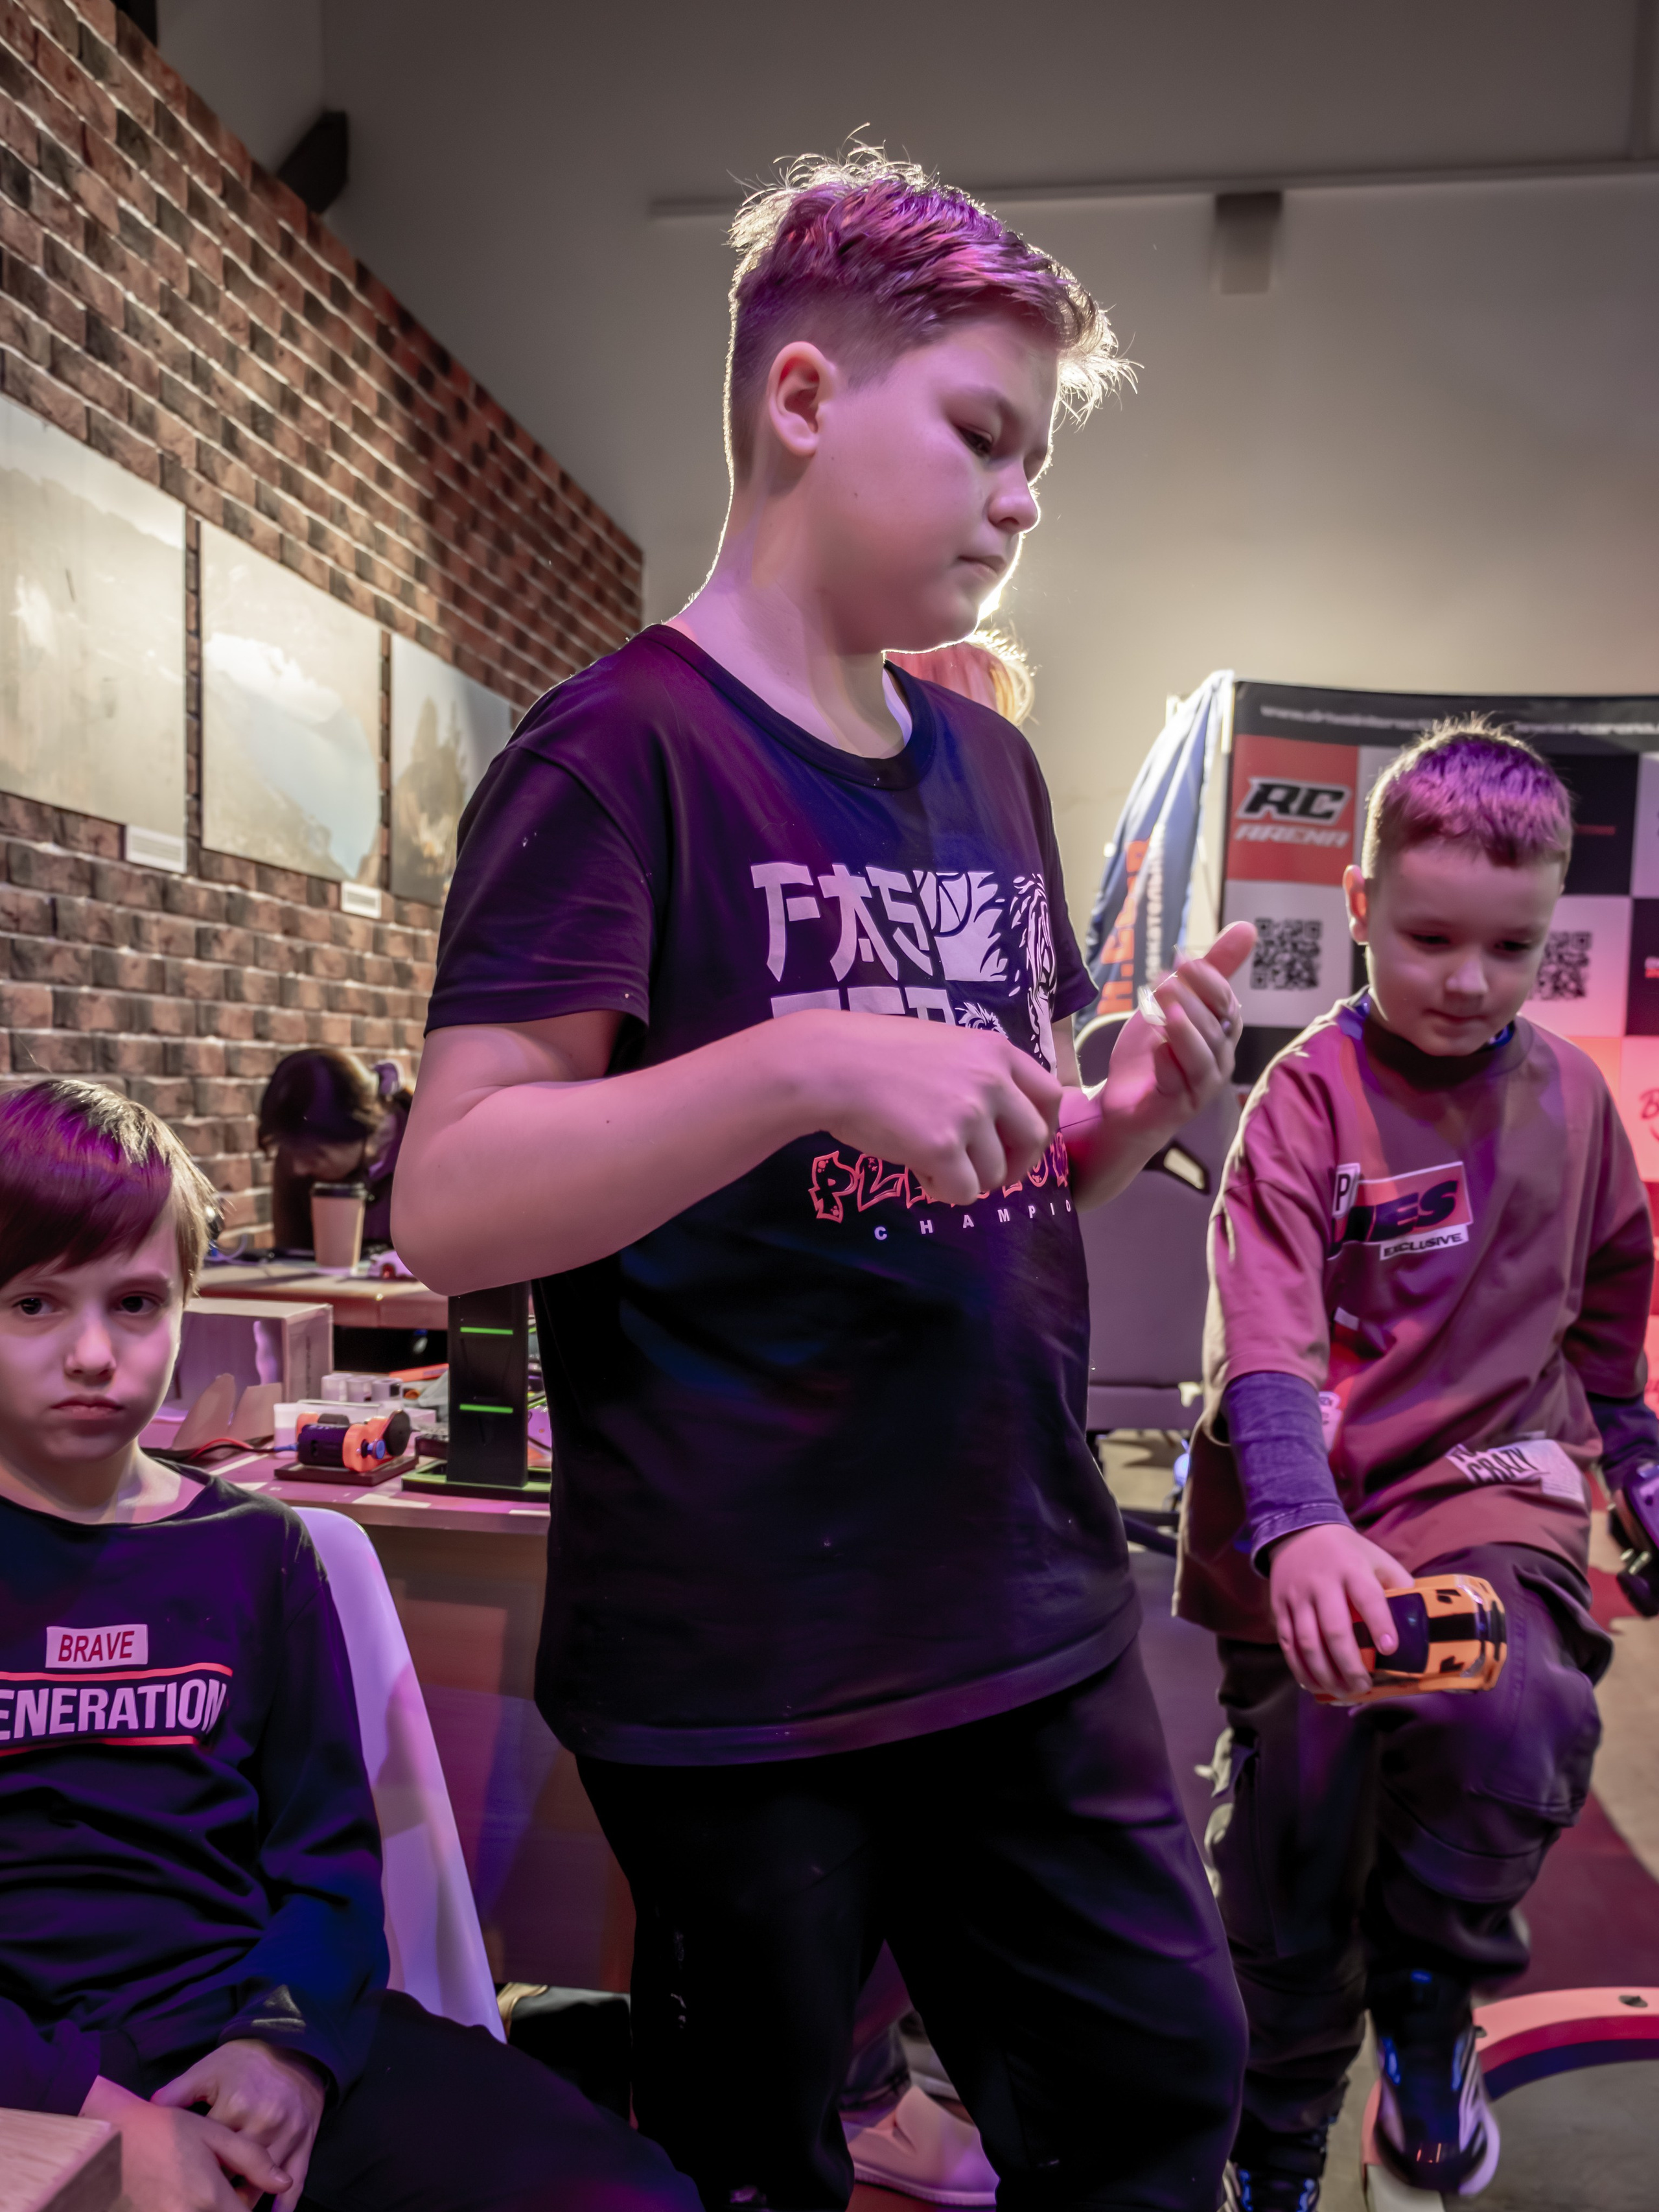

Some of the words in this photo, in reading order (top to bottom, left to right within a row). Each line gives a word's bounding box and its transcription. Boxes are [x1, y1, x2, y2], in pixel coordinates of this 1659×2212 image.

[1242, 782, 1348, 822] RC
[1384, 1233, 1463, 1257] EXCLUSIVE
[58, 1631, 135, 1662] BRAVE
